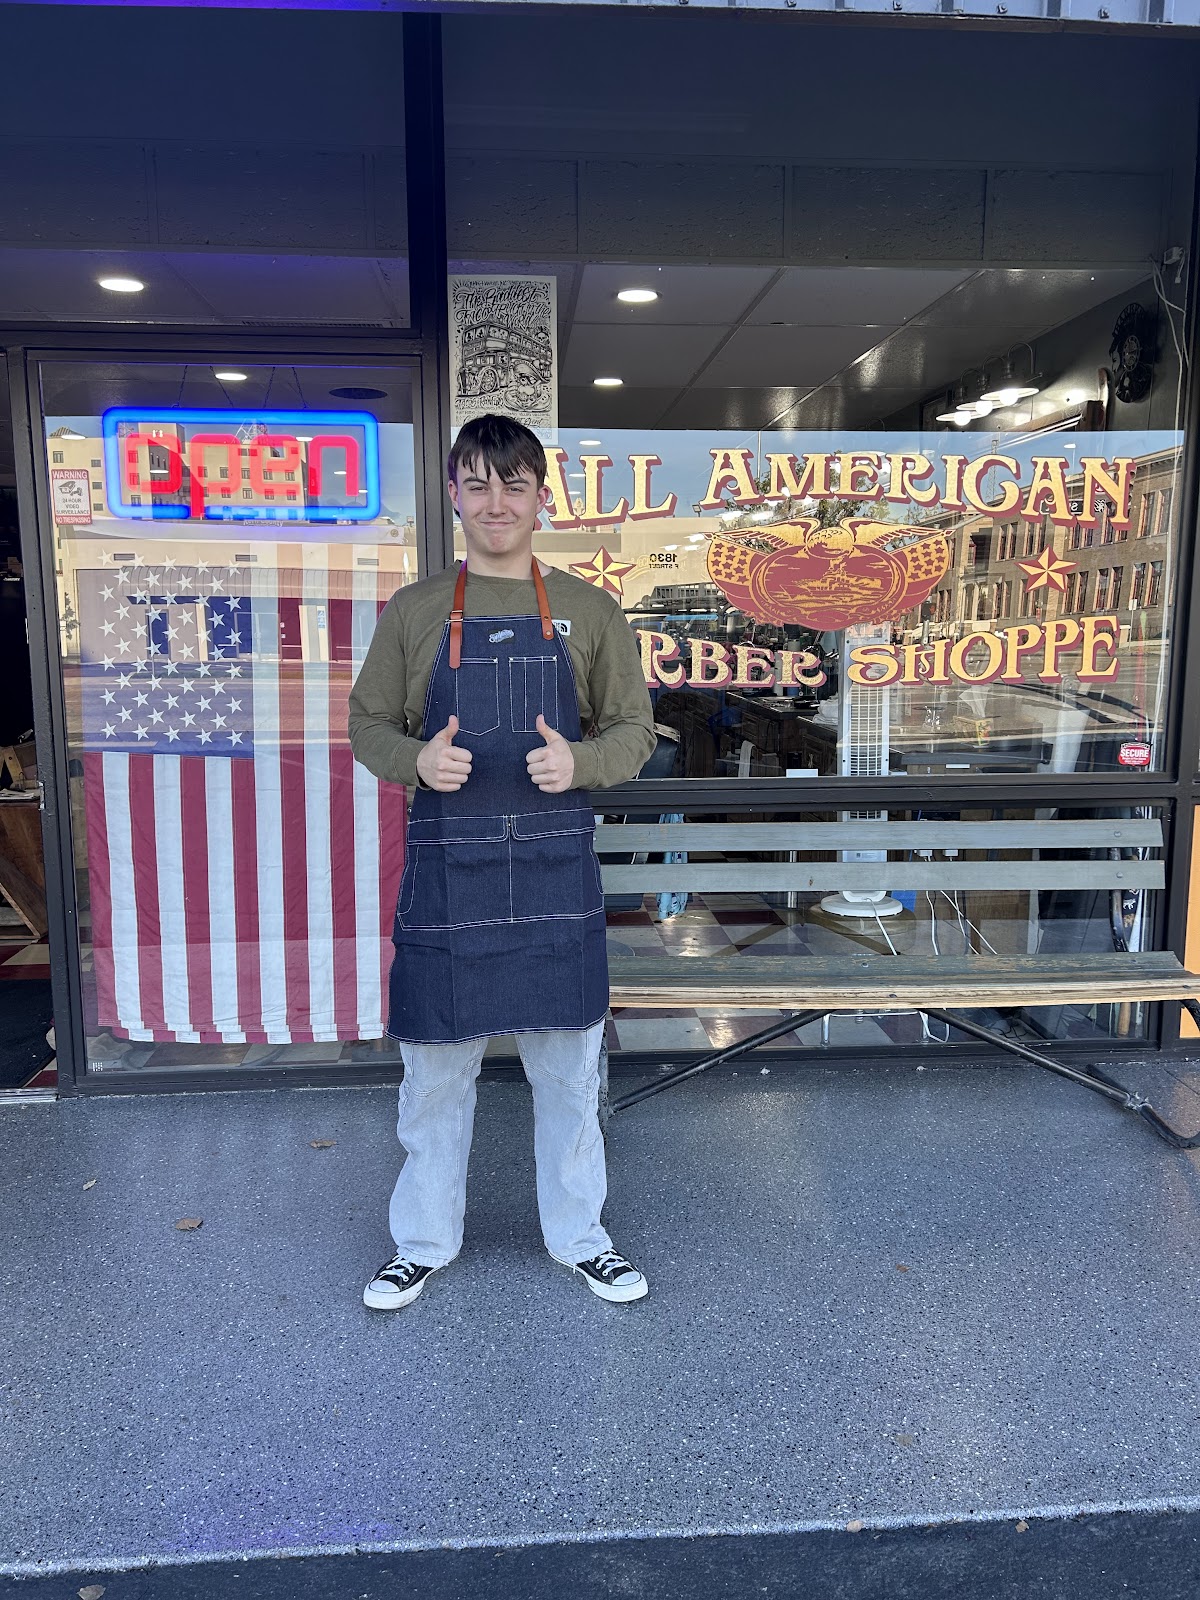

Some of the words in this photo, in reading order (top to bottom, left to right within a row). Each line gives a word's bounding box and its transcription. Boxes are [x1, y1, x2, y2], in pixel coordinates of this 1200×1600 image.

[53, 470, 87, 479] WARNING
[533, 447, 677, 530] ALL
[699, 447, 1136, 531] AMERICAN
[636, 629, 828, 689] RBER
[847, 615, 1120, 687] SHOPPE
[1120, 749, 1149, 757] SECURE
